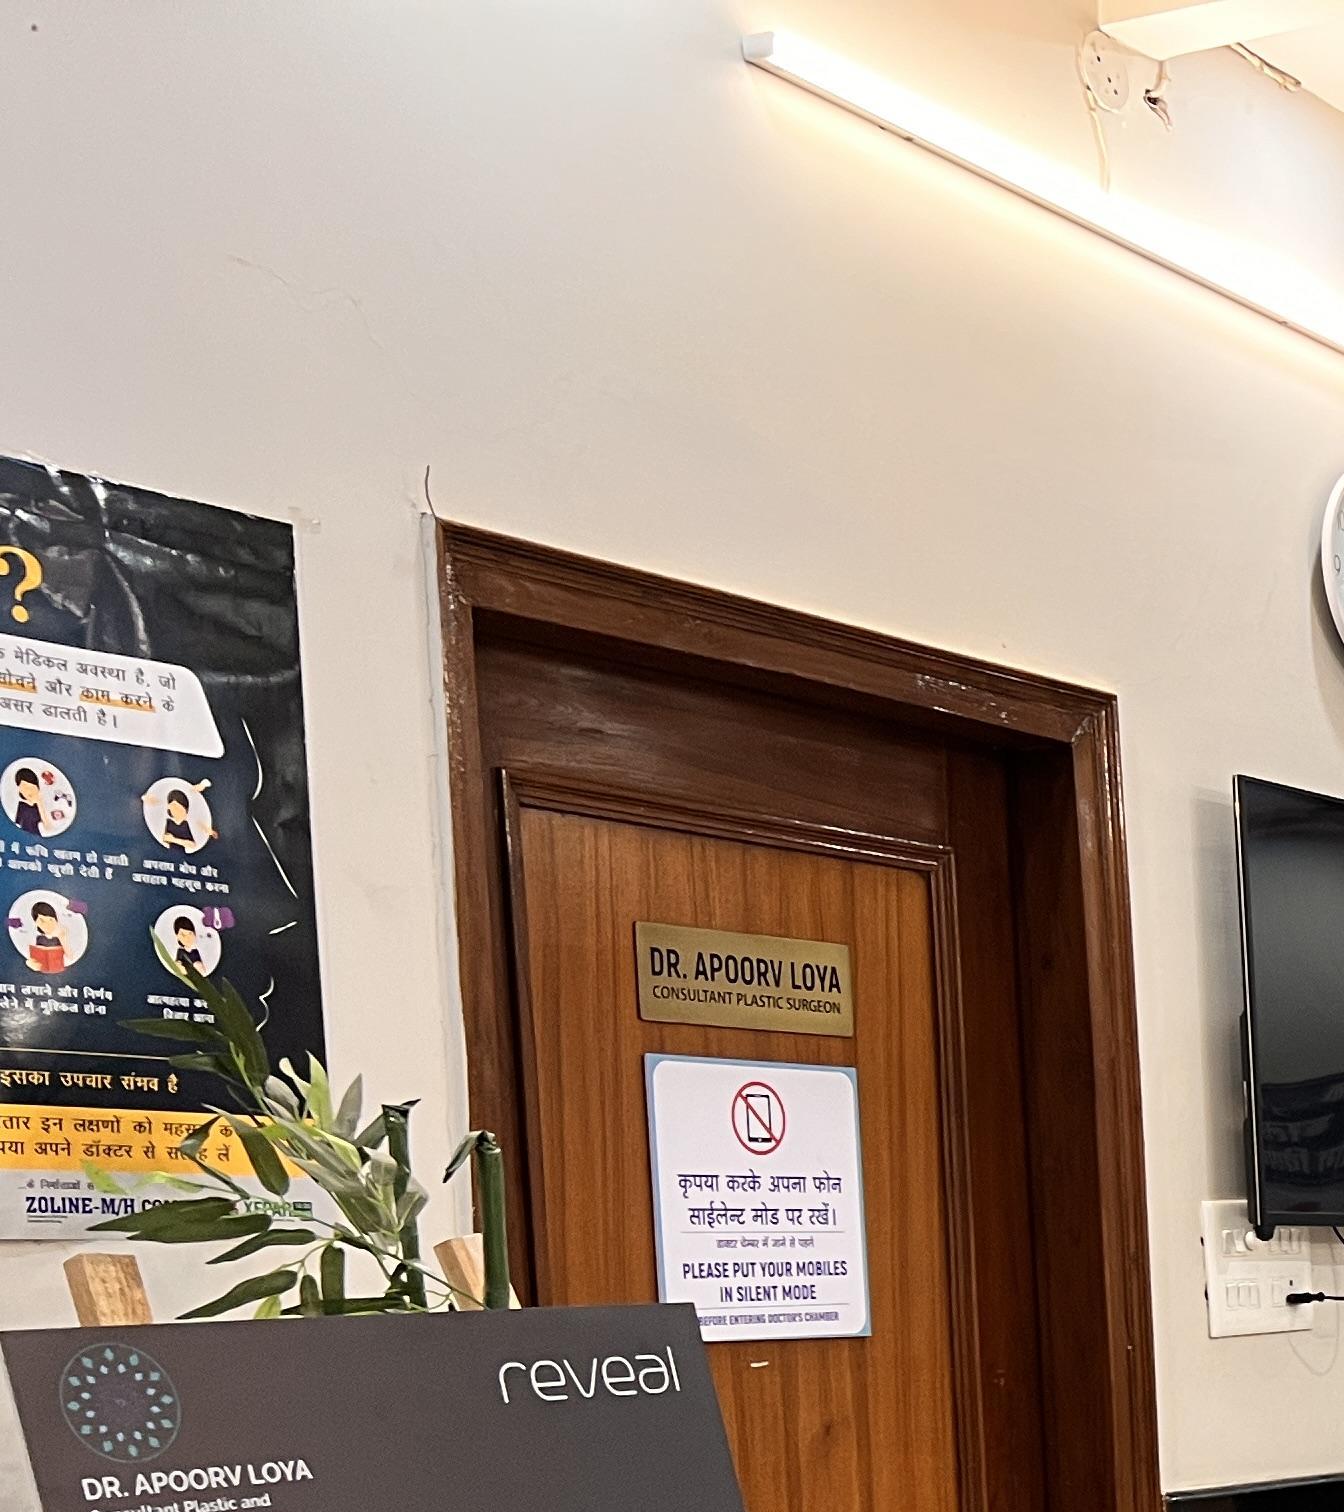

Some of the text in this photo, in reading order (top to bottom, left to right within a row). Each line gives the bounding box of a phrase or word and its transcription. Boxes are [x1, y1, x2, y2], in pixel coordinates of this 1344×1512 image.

[15, 647, 67, 671] मेडिकल
[77, 662, 125, 682] अवस्था
[159, 672, 176, 690] जो
[45, 678, 152, 710] और काम करने
[650, 947, 841, 994] DR. APOORV LOYA
[653, 985, 841, 1014] CONSULTANT PLASTIC SURGEON
[60, 1071, 178, 1093] उपचार संभव है
[40, 1116, 152, 1135] इन को
[35, 1138, 155, 1159] अपने डॉक्टर से
[678, 1169, 842, 1199] कृपया करके अपना फोन
[26, 1196, 135, 1215] ZOLINE-M/H
[688, 1201, 745, 1229] साईलेन्ट
[751, 1202, 779, 1225] मोड
[785, 1208, 803, 1225] पर
[683, 1260, 848, 1279] PLEASE PUT YOUR MOBILES
[720, 1284, 816, 1302] IN SILENT MODE
[498, 1345, 681, 1403] reveal
[81, 1459, 314, 1501] DR. APOORV LOYA
[240, 1493, 272, 1509] and
